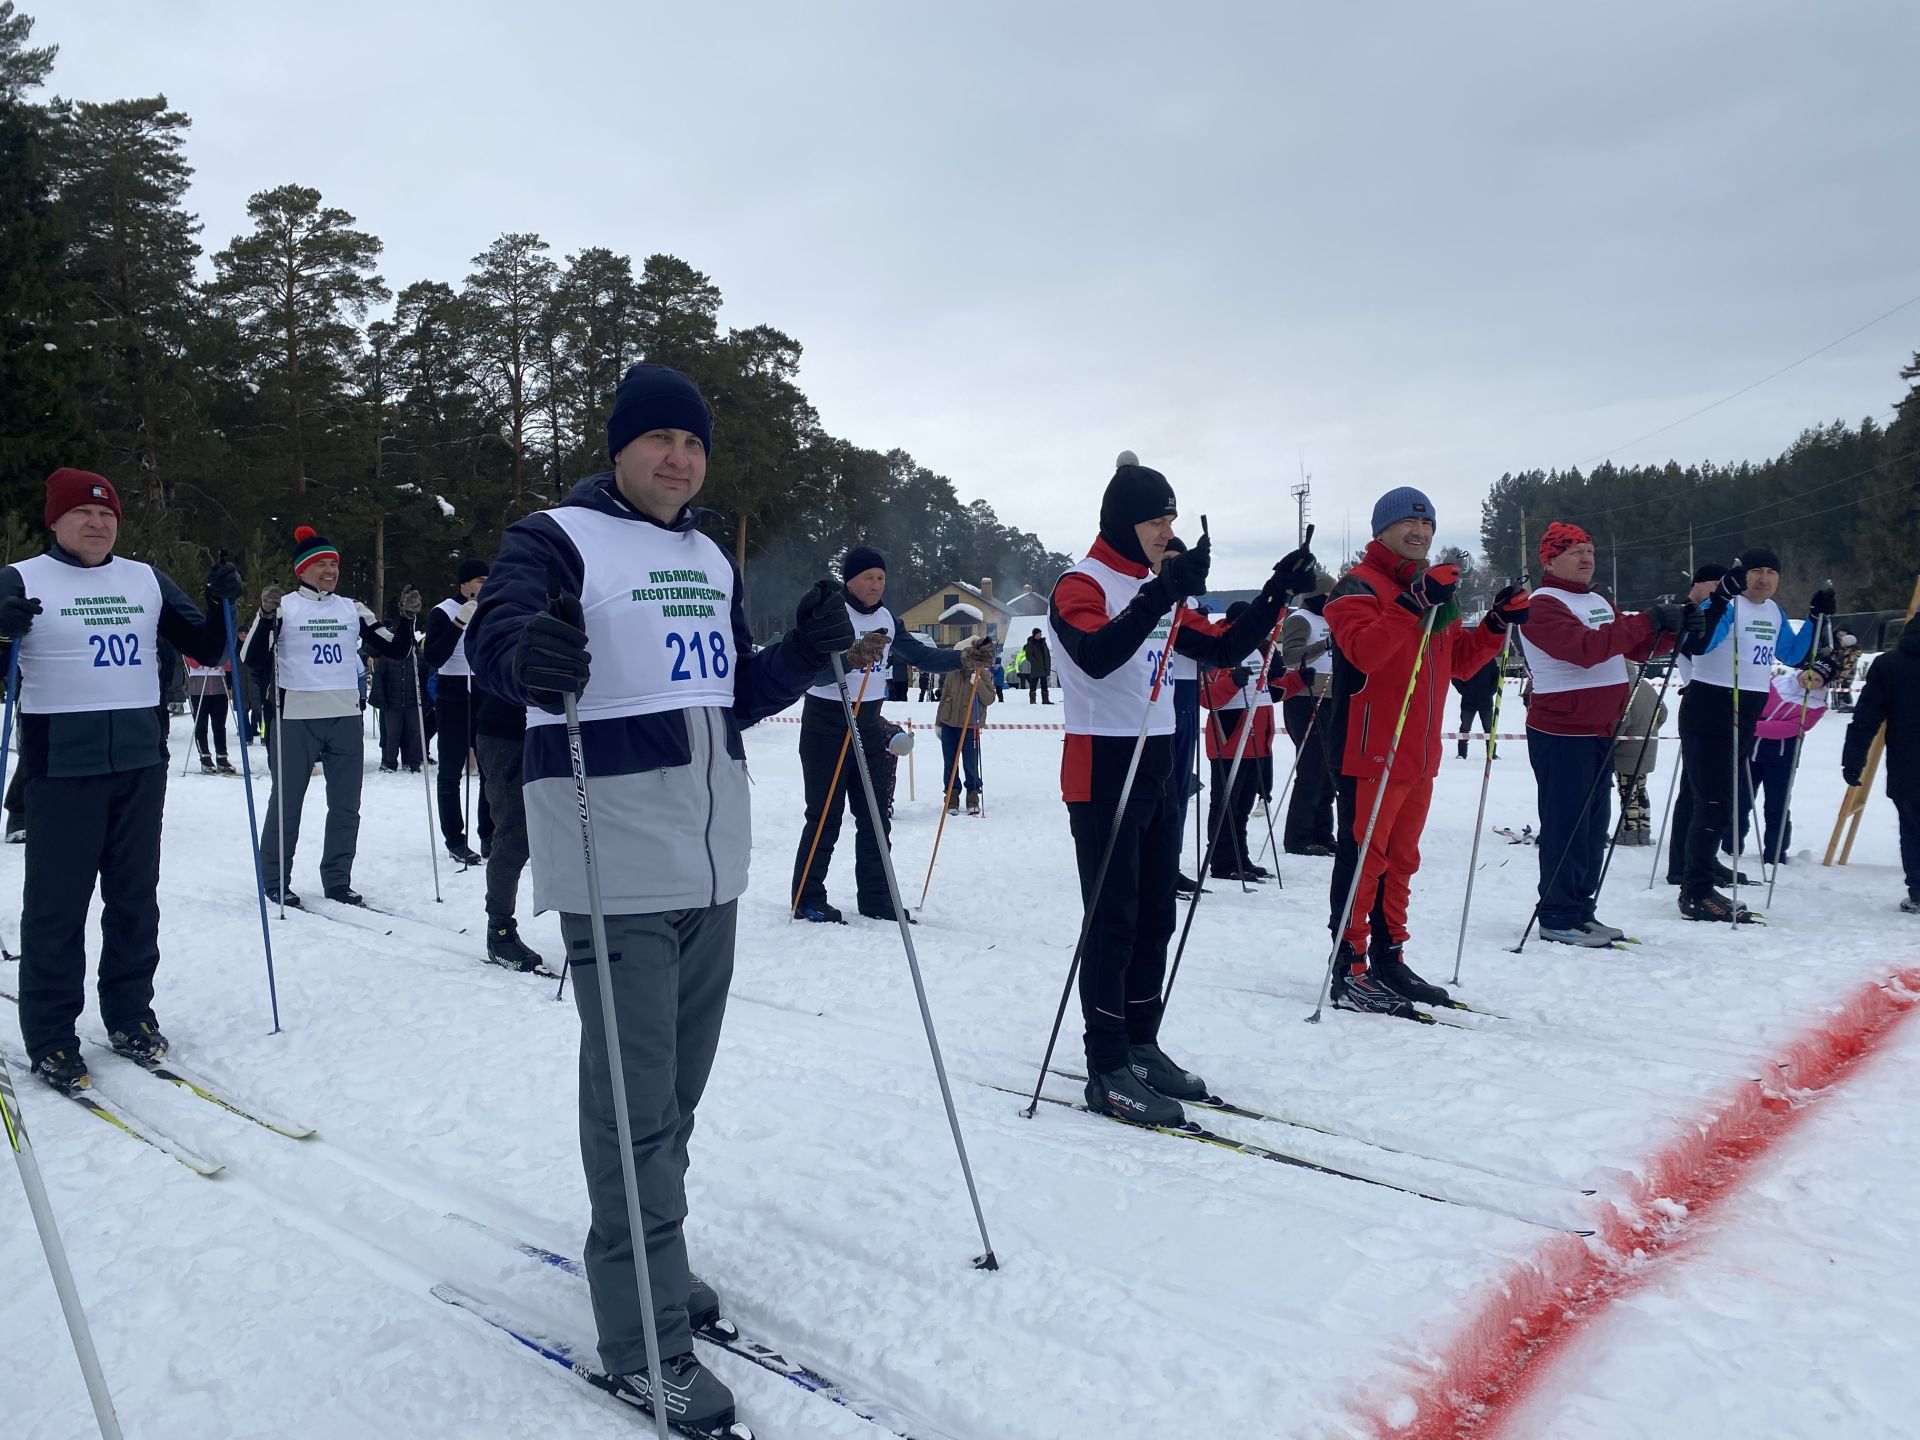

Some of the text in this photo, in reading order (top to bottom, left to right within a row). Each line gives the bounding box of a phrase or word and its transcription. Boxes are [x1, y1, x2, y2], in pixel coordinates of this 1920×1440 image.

[648, 569, 709, 584] ЛУБЯНСКИЙ
[74, 595, 127, 606] ЛУБЯНСКИЙ
[60, 605, 145, 617] ЛЕСОТЕХНИЧЕСКИЙ
[662, 604, 716, 619] КОЛЛЕДЖ
[83, 616, 131, 626] КОЛЛЕДЖ
[89, 633, 142, 667] 202
[311, 643, 343, 665] 260
[665, 631, 729, 681] 218
[1752, 645, 1773, 666] 286
[1108, 1090, 1148, 1113] SPINE
